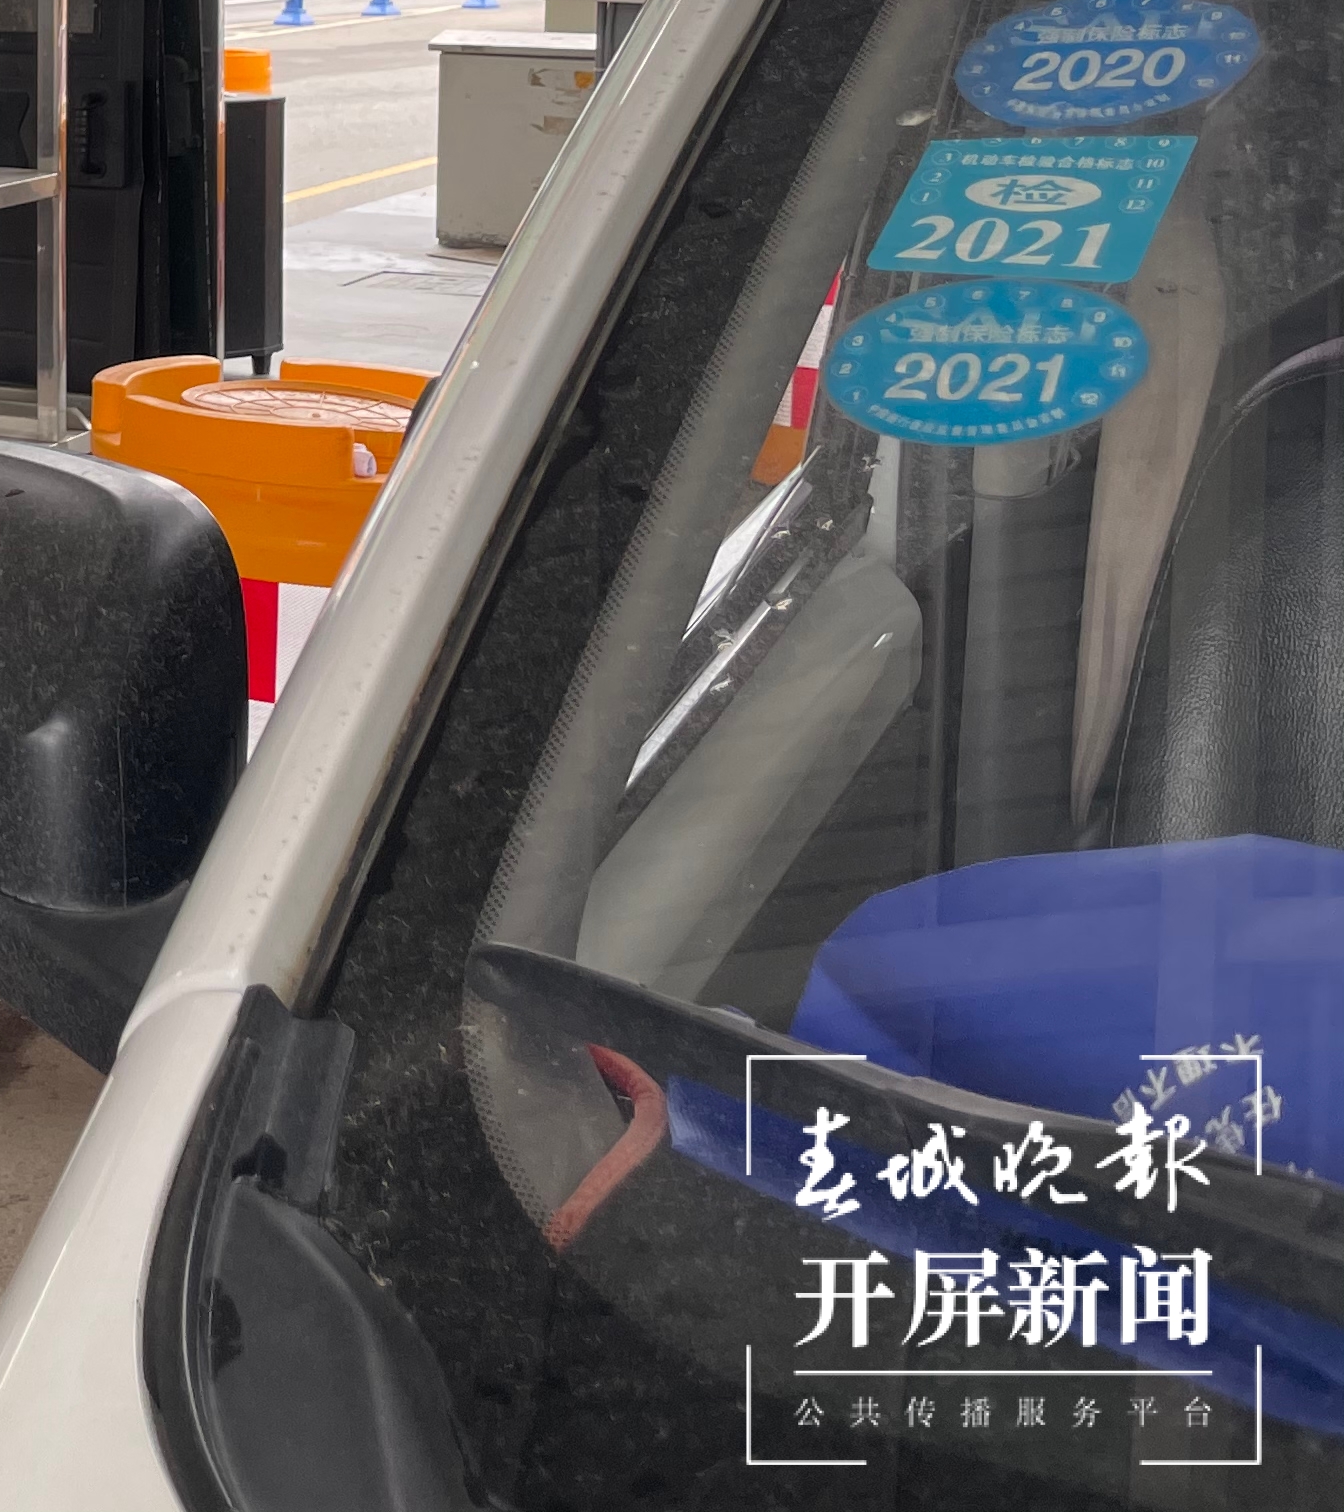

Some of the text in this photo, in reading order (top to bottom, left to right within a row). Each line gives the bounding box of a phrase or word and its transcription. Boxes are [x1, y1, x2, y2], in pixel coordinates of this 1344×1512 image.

[1012, 46, 1186, 91] 2020
[894, 215, 1110, 268] 2021
[883, 352, 1065, 403] 2021
